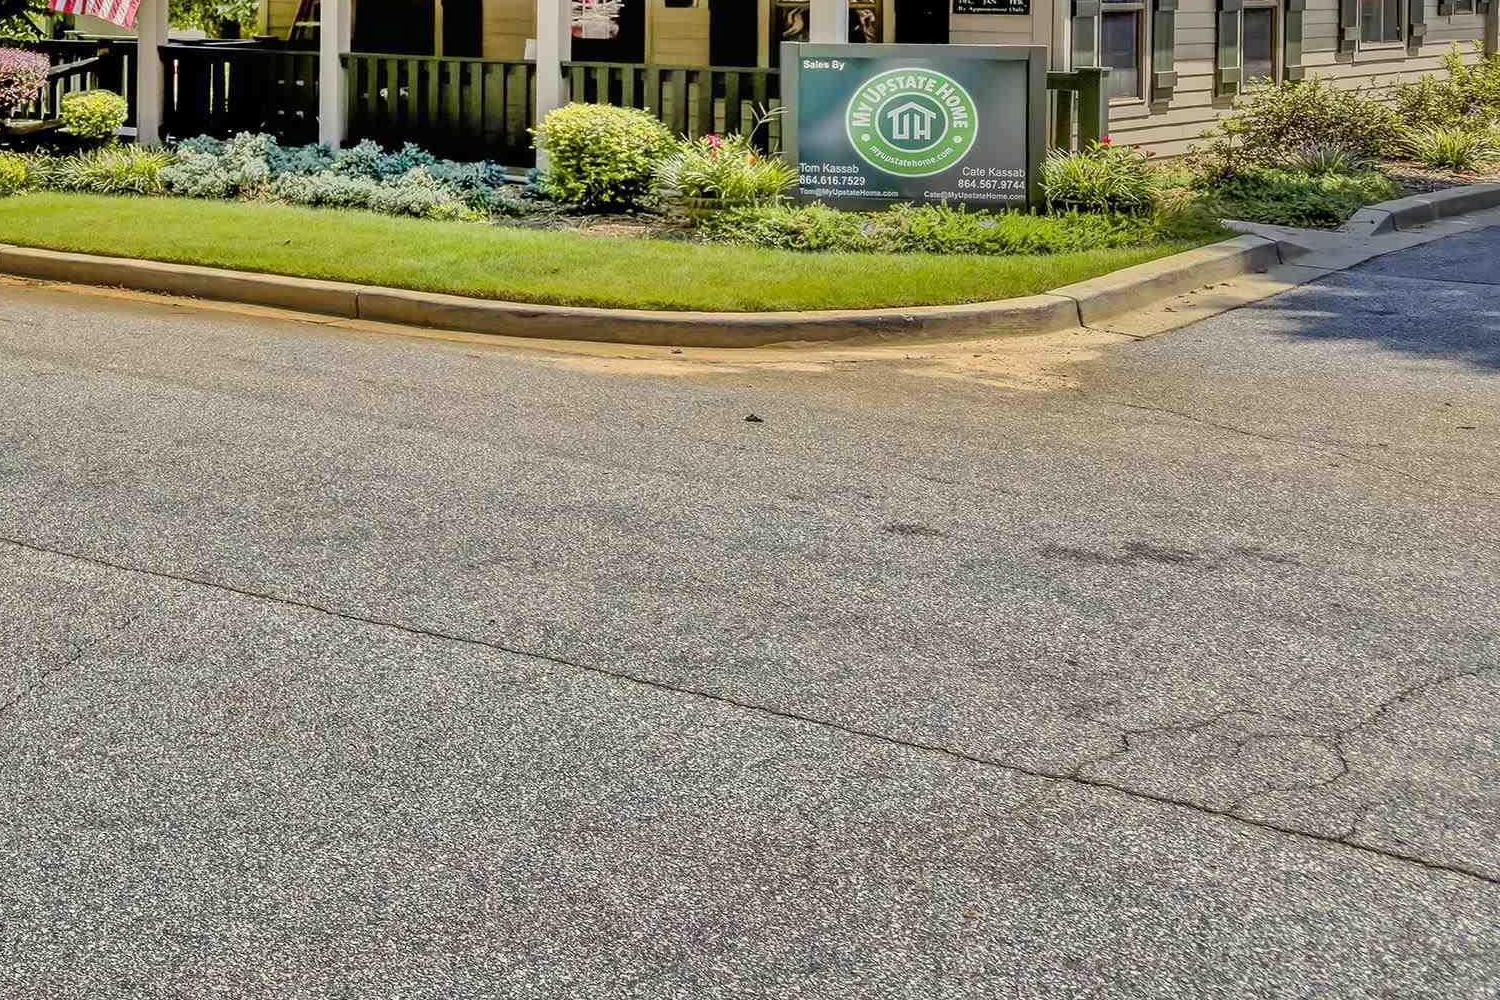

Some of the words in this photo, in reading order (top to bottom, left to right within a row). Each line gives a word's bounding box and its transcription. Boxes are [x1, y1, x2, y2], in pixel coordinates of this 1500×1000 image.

[803, 60, 830, 69] Sales
[831, 60, 845, 71] By
[861, 75, 938, 104] UPSTATE
[935, 82, 969, 128] HOME
[869, 144, 954, 168] myupstatehome.com
[799, 162, 820, 173] Tom
[822, 162, 860, 173] Kassab
[962, 166, 986, 176] Cate
[988, 167, 1026, 178] Kassab
[957, 179, 1026, 190] 864.567.9744
